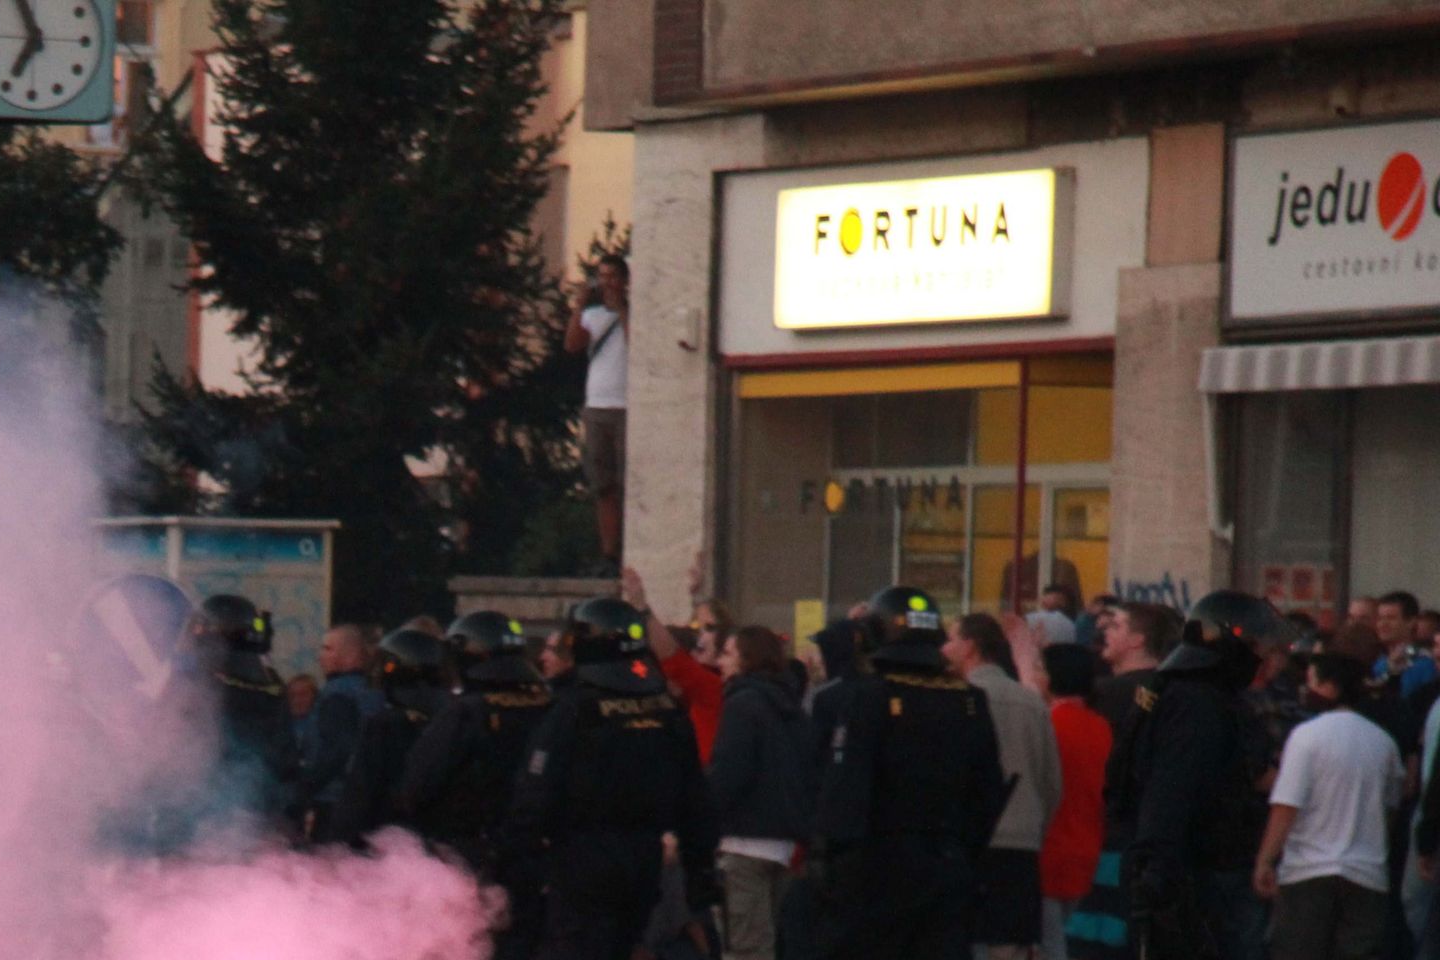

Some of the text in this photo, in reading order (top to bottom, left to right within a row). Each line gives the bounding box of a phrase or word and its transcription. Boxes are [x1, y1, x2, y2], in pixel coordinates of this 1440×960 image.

[814, 203, 1010, 256] FORTUNA
[1268, 166, 1370, 247] jedu
[800, 475, 963, 515] FORTUNA
